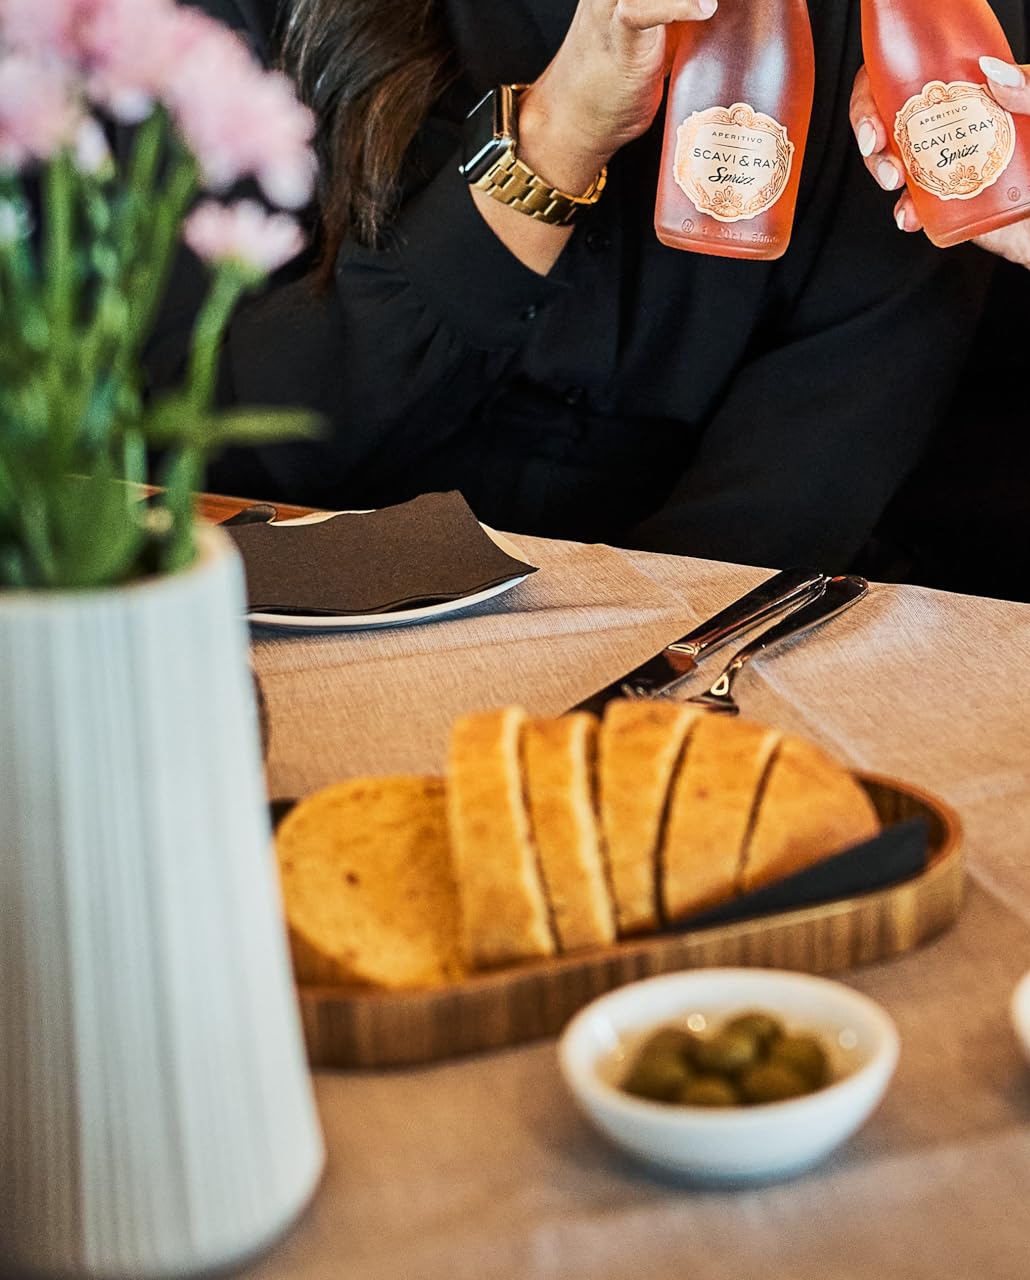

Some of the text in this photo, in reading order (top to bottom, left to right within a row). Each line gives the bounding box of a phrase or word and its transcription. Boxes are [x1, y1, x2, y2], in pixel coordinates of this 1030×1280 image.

[919, 105, 968, 125] APERITIVO
[711, 131, 763, 144] APERITIVO
[913, 117, 995, 153] SCAVI & RAY
[693, 147, 778, 169] SCAVI & RAY
[936, 143, 979, 168] Sprizz
[708, 166, 755, 186] Sprizz
